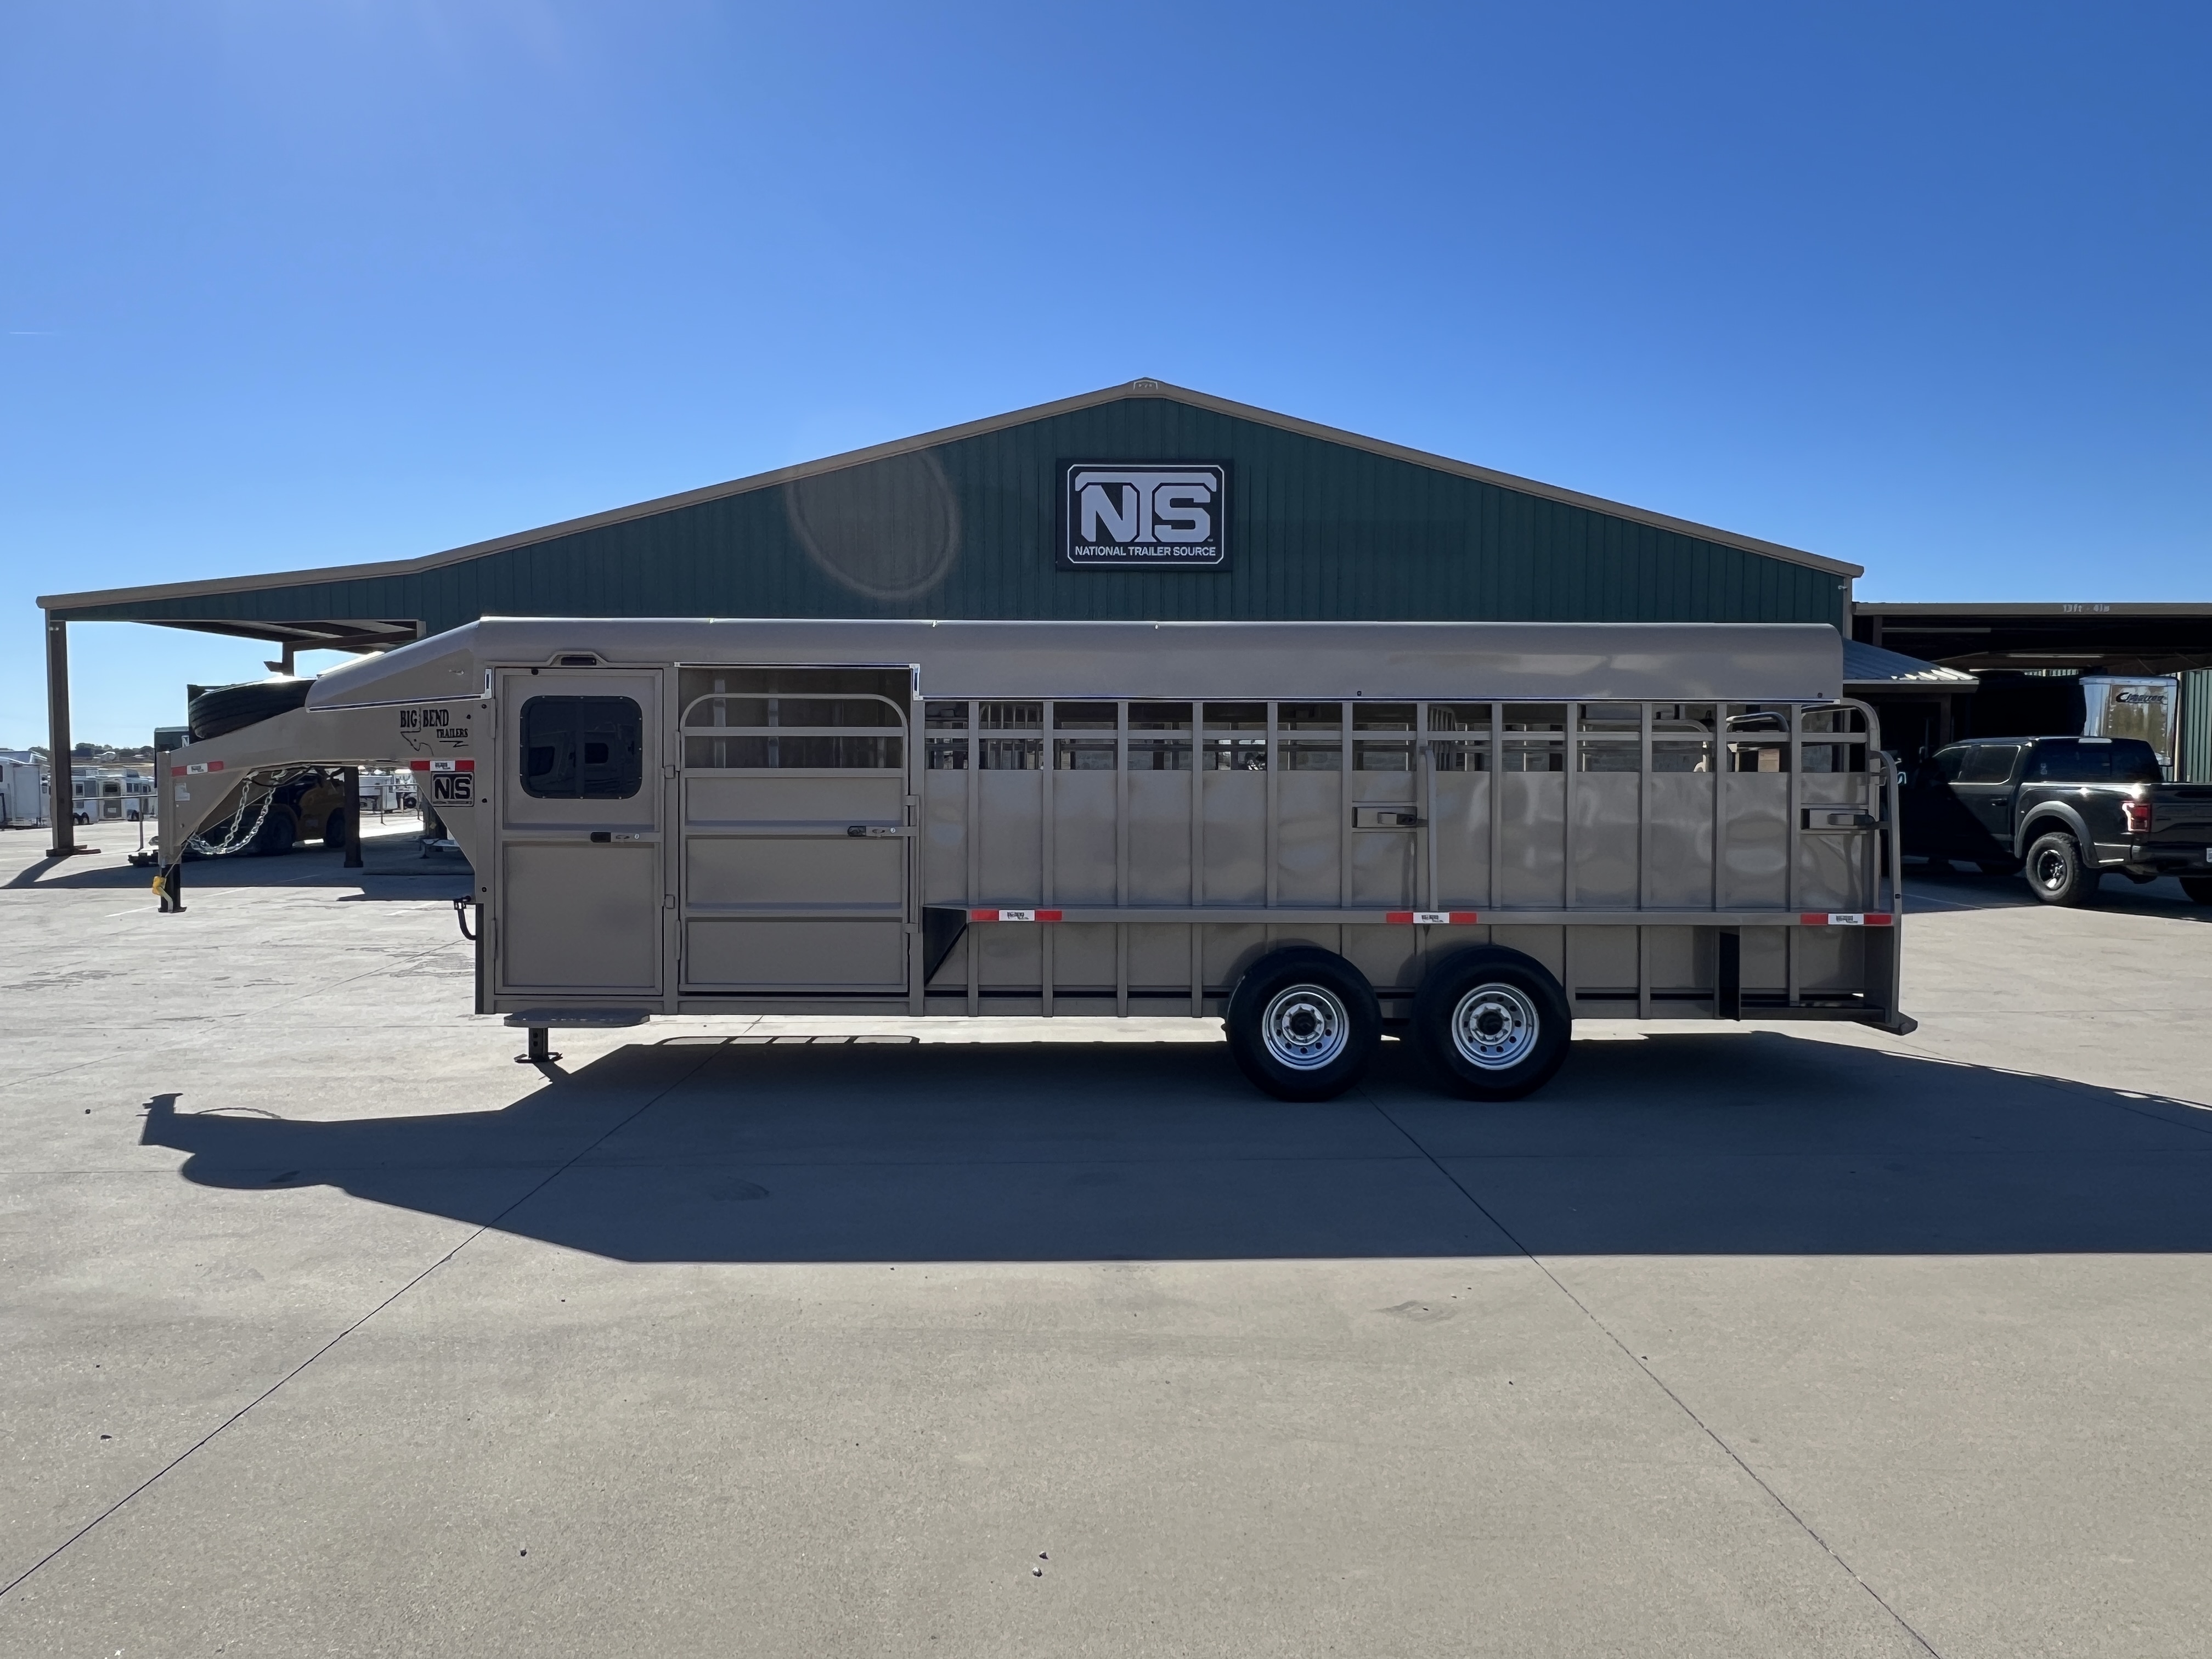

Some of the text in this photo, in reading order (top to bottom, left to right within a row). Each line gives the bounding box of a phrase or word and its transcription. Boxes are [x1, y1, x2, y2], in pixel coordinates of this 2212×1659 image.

[1075, 472, 1217, 543] NTS
[1075, 546, 1216, 556] NATIONAL TRAILER SOURCE
[400, 709, 449, 727] BIG BEND
[436, 728, 469, 738] TRAILERS
[433, 774, 472, 799] NTS
